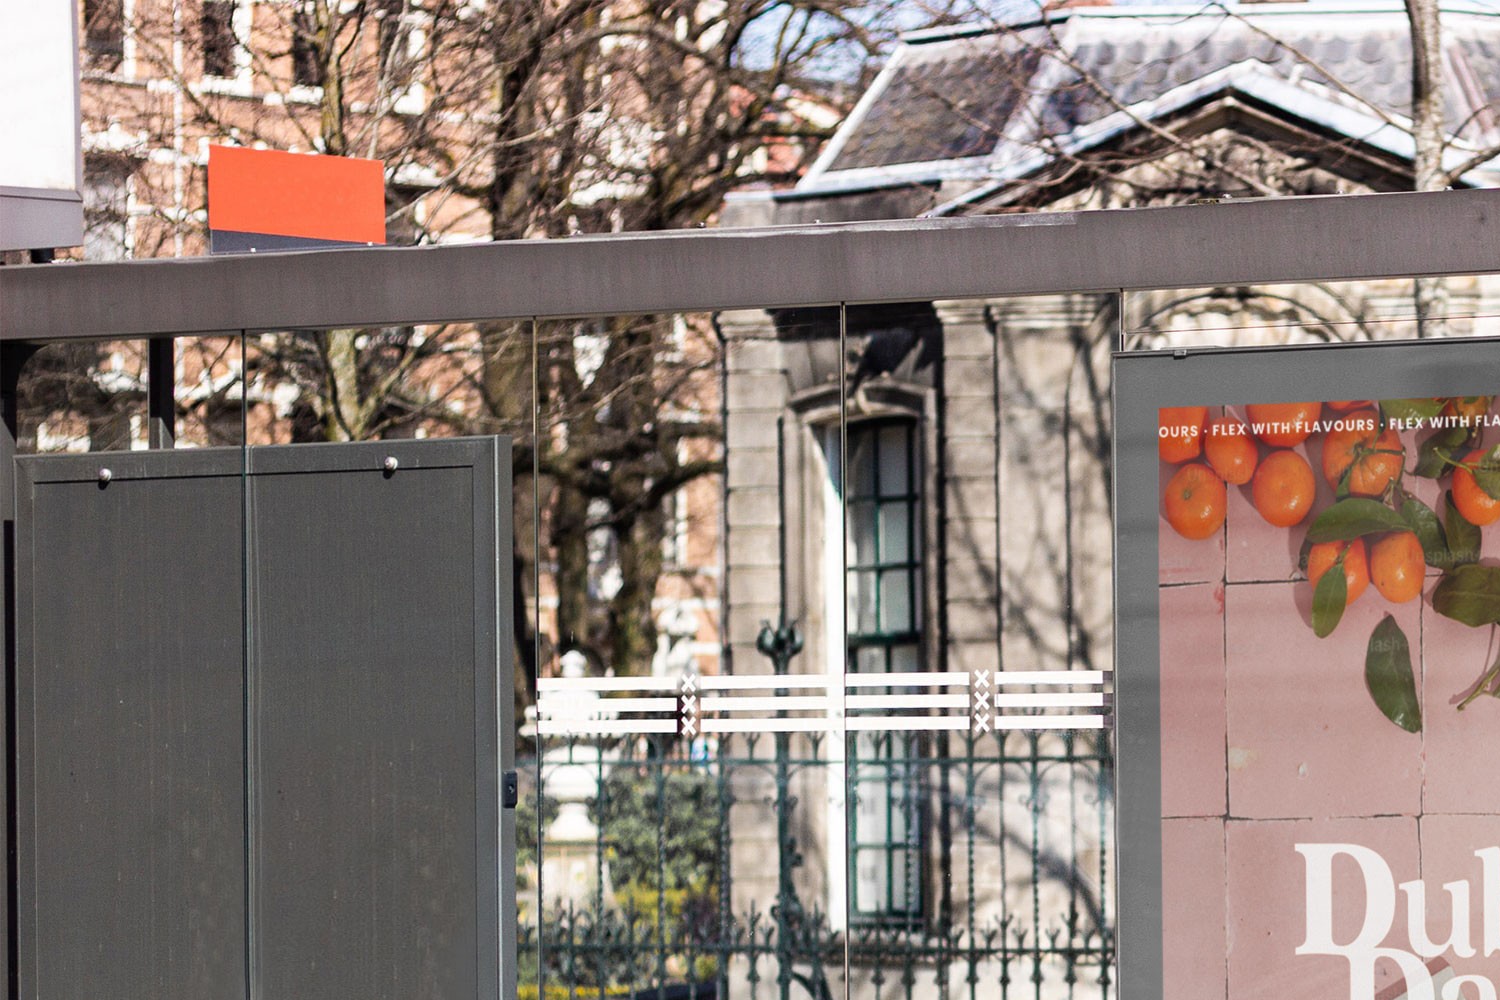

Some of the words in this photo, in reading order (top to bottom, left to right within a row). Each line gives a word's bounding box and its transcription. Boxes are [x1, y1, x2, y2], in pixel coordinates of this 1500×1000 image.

[1158, 425, 1198, 438] OURS
[1213, 423, 1246, 436] FLEX
[1252, 422, 1290, 434] WITH
[1296, 419, 1374, 433] FLAVOURS
[1389, 417, 1423, 430] FLEX
[1429, 416, 1469, 428] WITH
